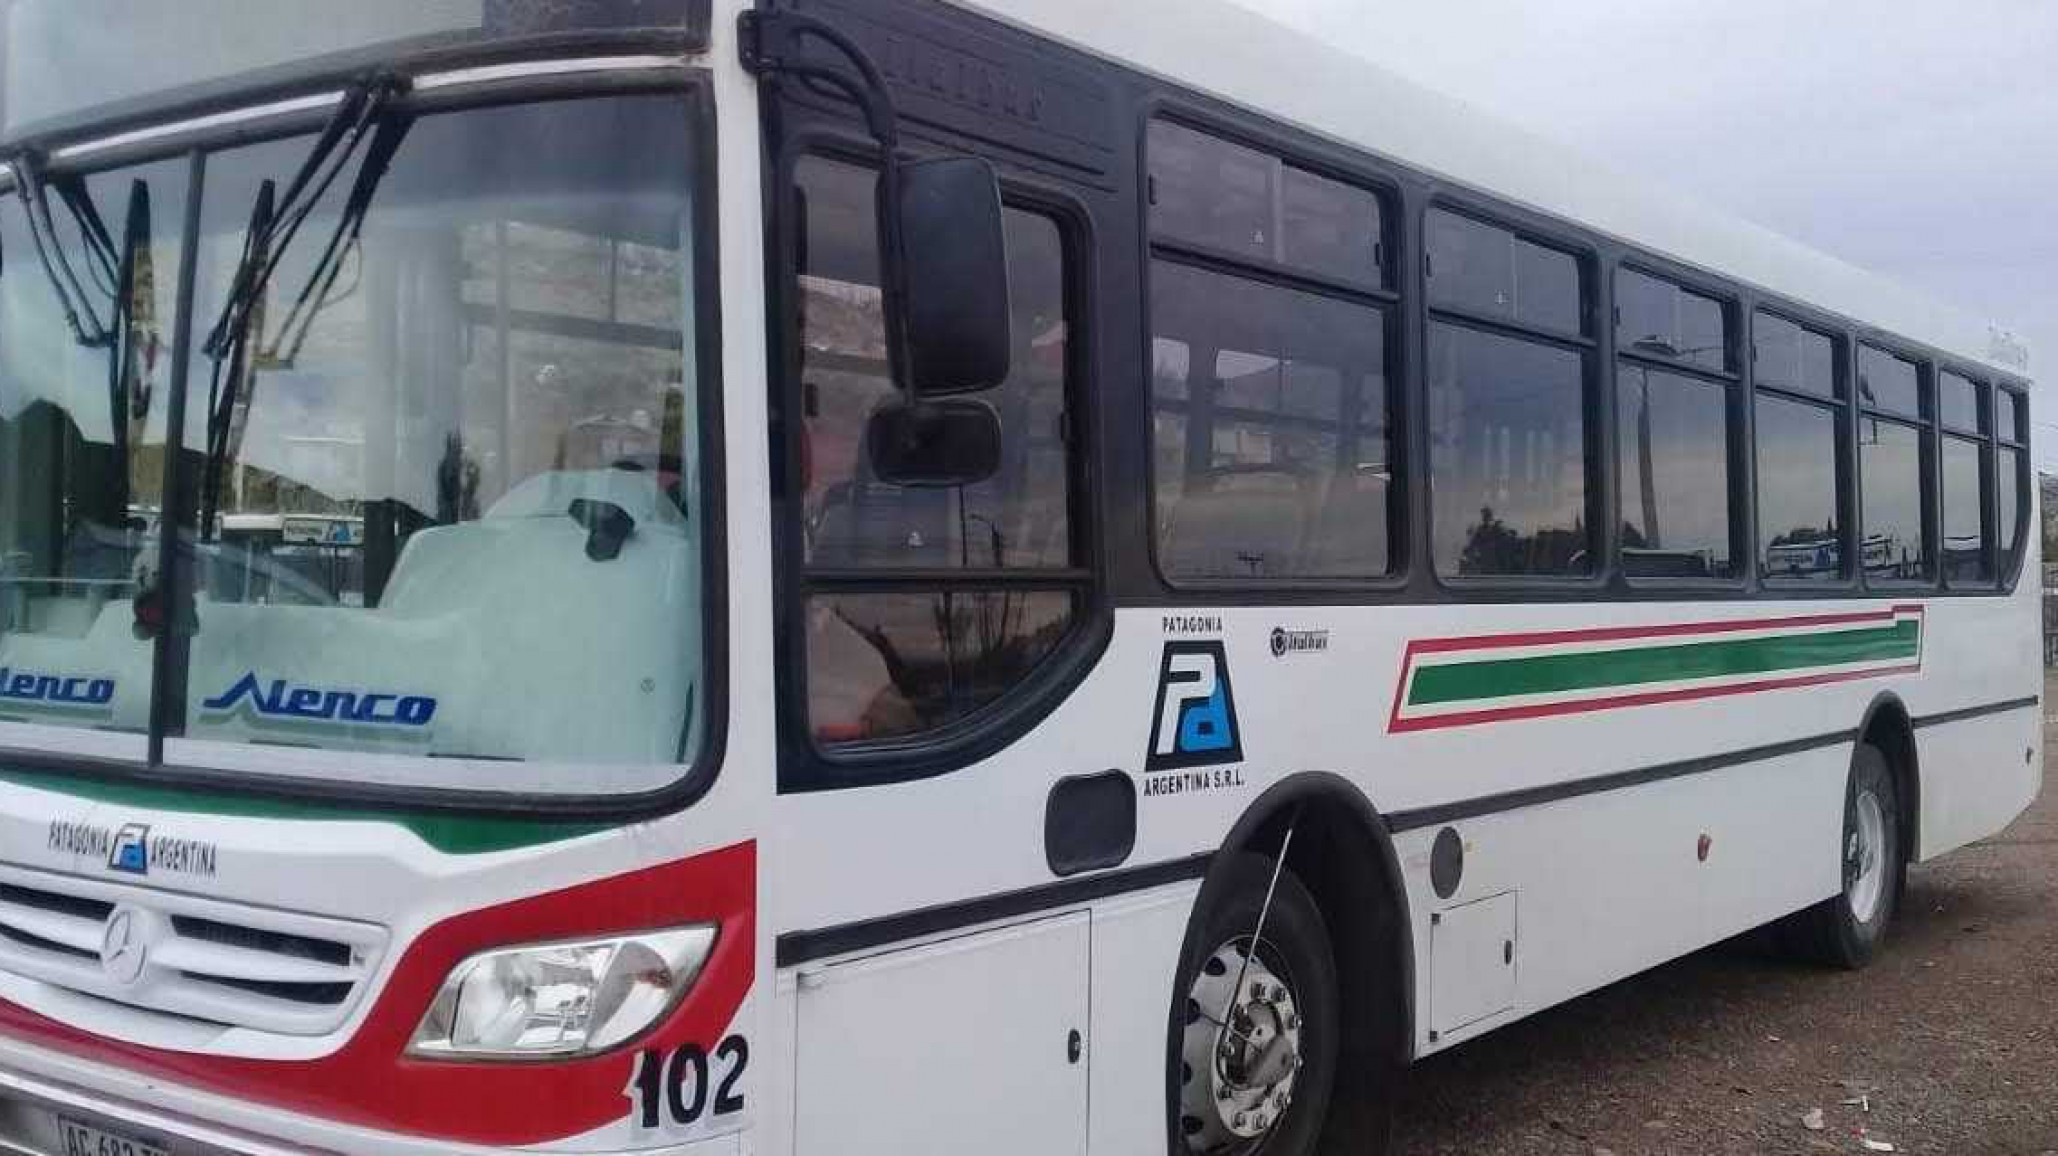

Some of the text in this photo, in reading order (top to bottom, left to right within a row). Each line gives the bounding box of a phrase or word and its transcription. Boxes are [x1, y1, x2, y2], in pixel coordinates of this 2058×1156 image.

[1163, 616, 1223, 633] PATAGONIA
[0, 667, 116, 705] lenco
[203, 671, 437, 726] Alenco
[1144, 769, 1245, 796] ARGENTINA S.R.L.
[49, 819, 109, 857] PATAGONIA
[152, 836, 217, 877] ARGENTINA
[635, 1034, 749, 1128] 102
